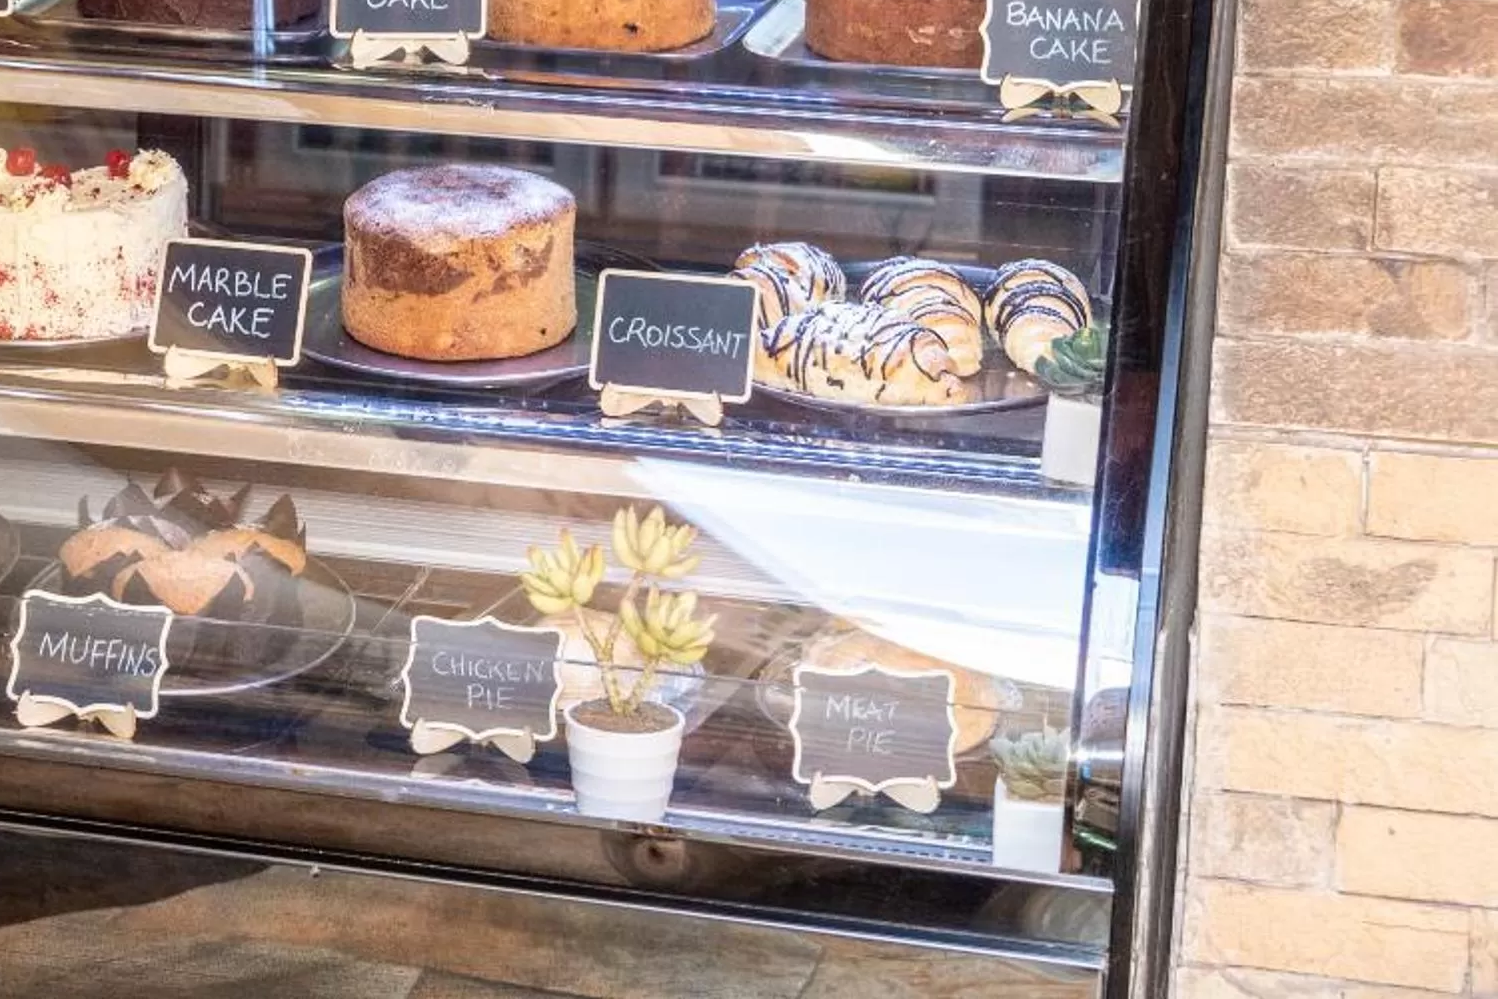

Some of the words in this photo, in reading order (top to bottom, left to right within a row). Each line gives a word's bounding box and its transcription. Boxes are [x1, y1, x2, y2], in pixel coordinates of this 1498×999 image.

[1006, 1, 1125, 32] BANANA
[1030, 36, 1112, 64] CAKE
[168, 264, 292, 299] MARBLE
[188, 302, 274, 338] CAKE
[609, 317, 746, 359] CROISSANT
[39, 632, 158, 676] MUFFINS
[432, 652, 544, 682] CHICKEN
[467, 683, 515, 709] PIE
[826, 694, 899, 725] MEAT
[847, 728, 896, 754] PIE
